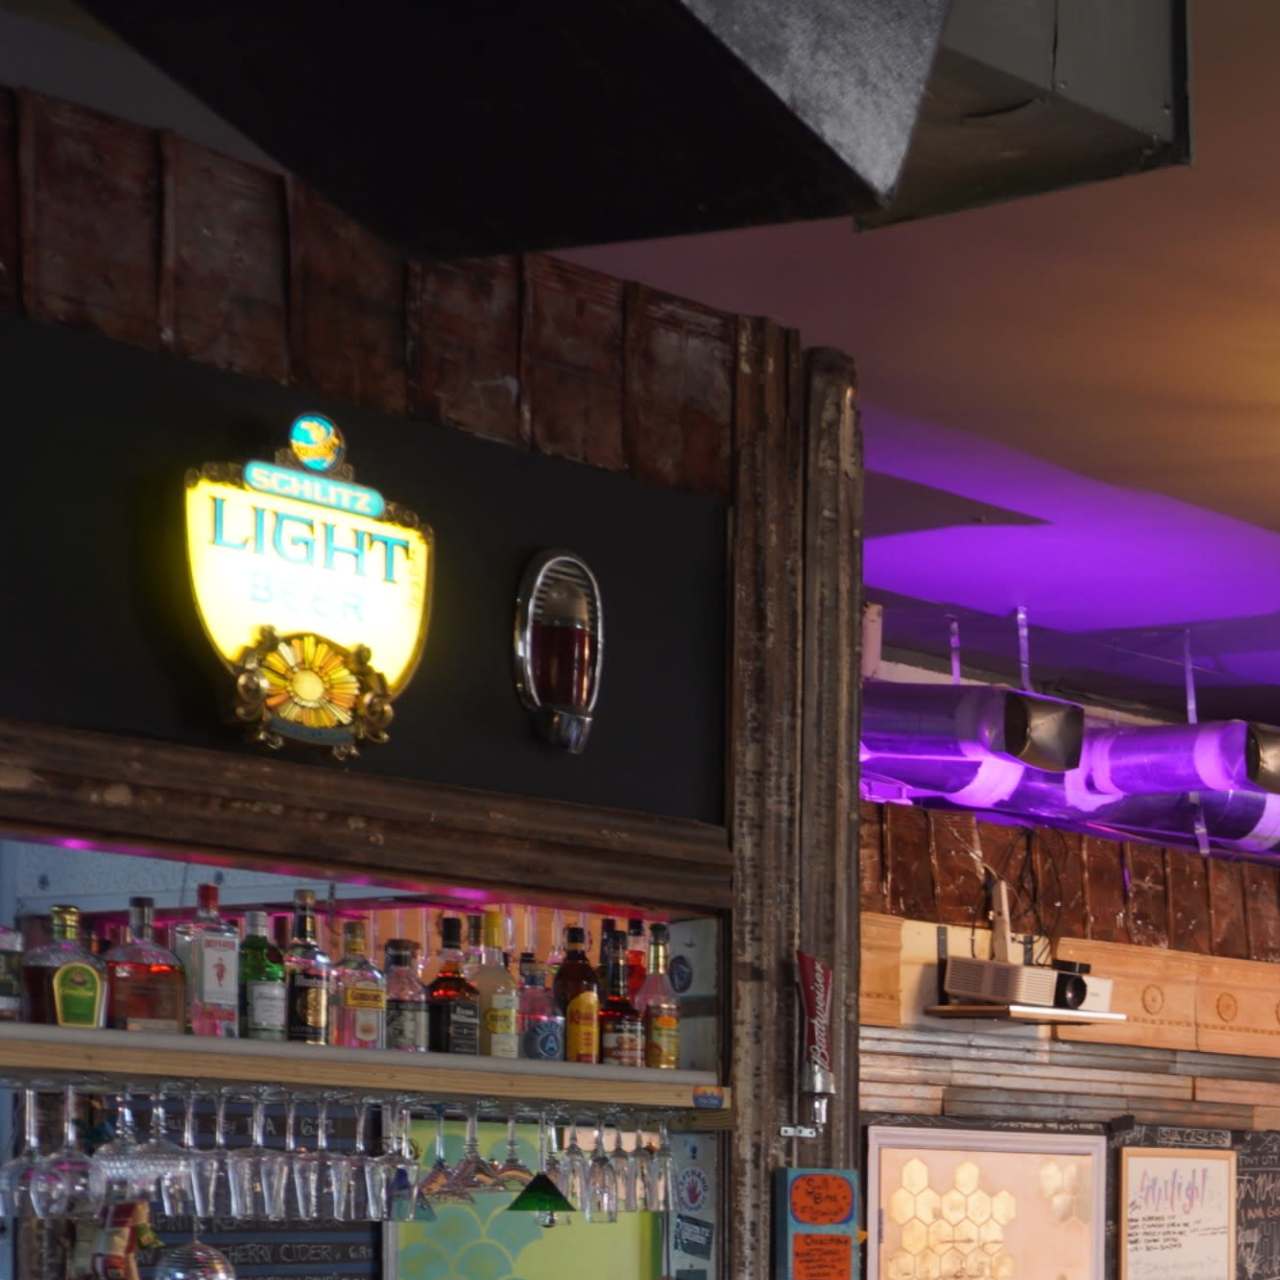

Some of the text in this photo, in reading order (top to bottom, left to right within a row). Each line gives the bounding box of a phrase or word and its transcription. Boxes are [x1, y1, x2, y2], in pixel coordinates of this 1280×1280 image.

[251, 467, 373, 513] SCHLITZ
[208, 495, 413, 584] LIGHT
[247, 567, 367, 622] BEER
